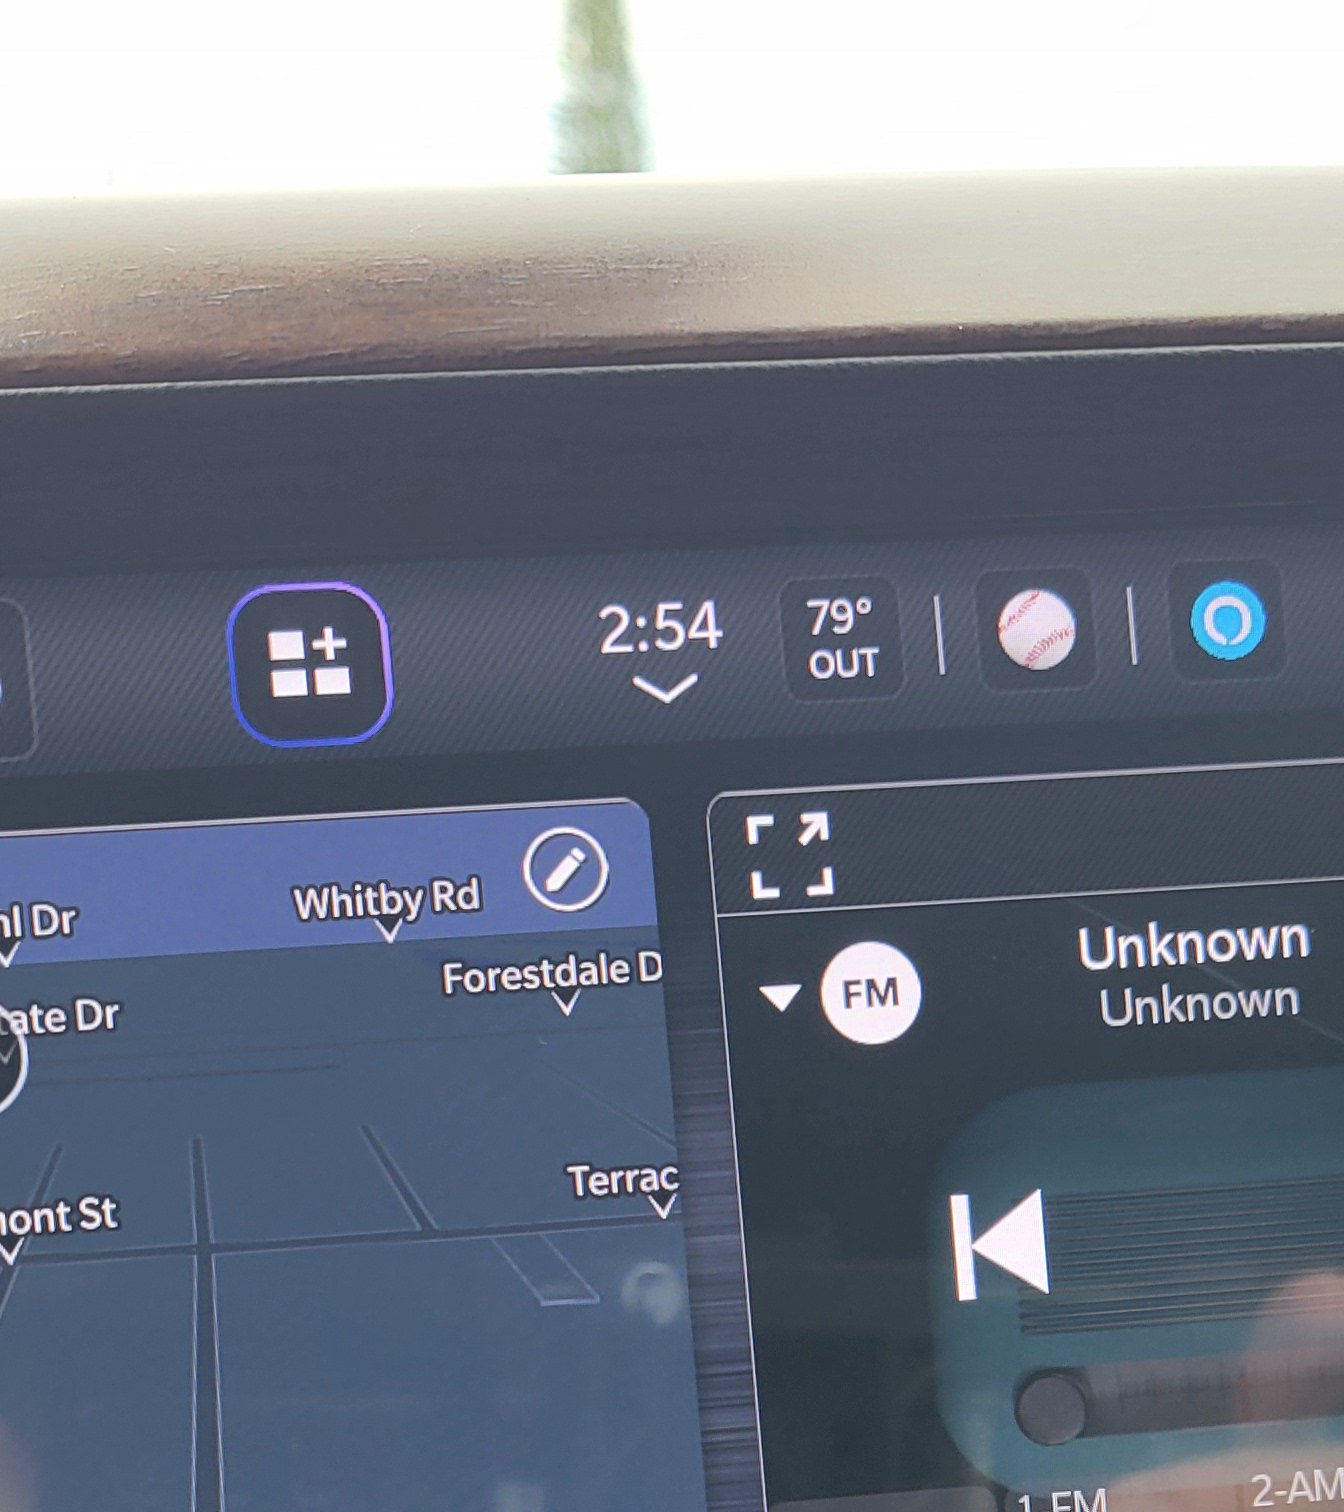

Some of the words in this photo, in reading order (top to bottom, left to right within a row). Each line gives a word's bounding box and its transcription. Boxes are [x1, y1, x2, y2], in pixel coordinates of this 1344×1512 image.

[599, 602, 724, 655] 2:54
[808, 648, 880, 681] OUT
[293, 882, 425, 922] Whitby
[432, 878, 481, 914] Rd
[32, 904, 77, 937] Dr
[1078, 922, 1312, 972] Unknown
[441, 955, 631, 994] Forestdale
[639, 951, 663, 983] D
[842, 977, 901, 1010] FM
[1100, 985, 1301, 1027] Unknown
[76, 999, 120, 1032] Dr
[567, 1165, 679, 1197] Terrac
[79, 1198, 119, 1232] St
